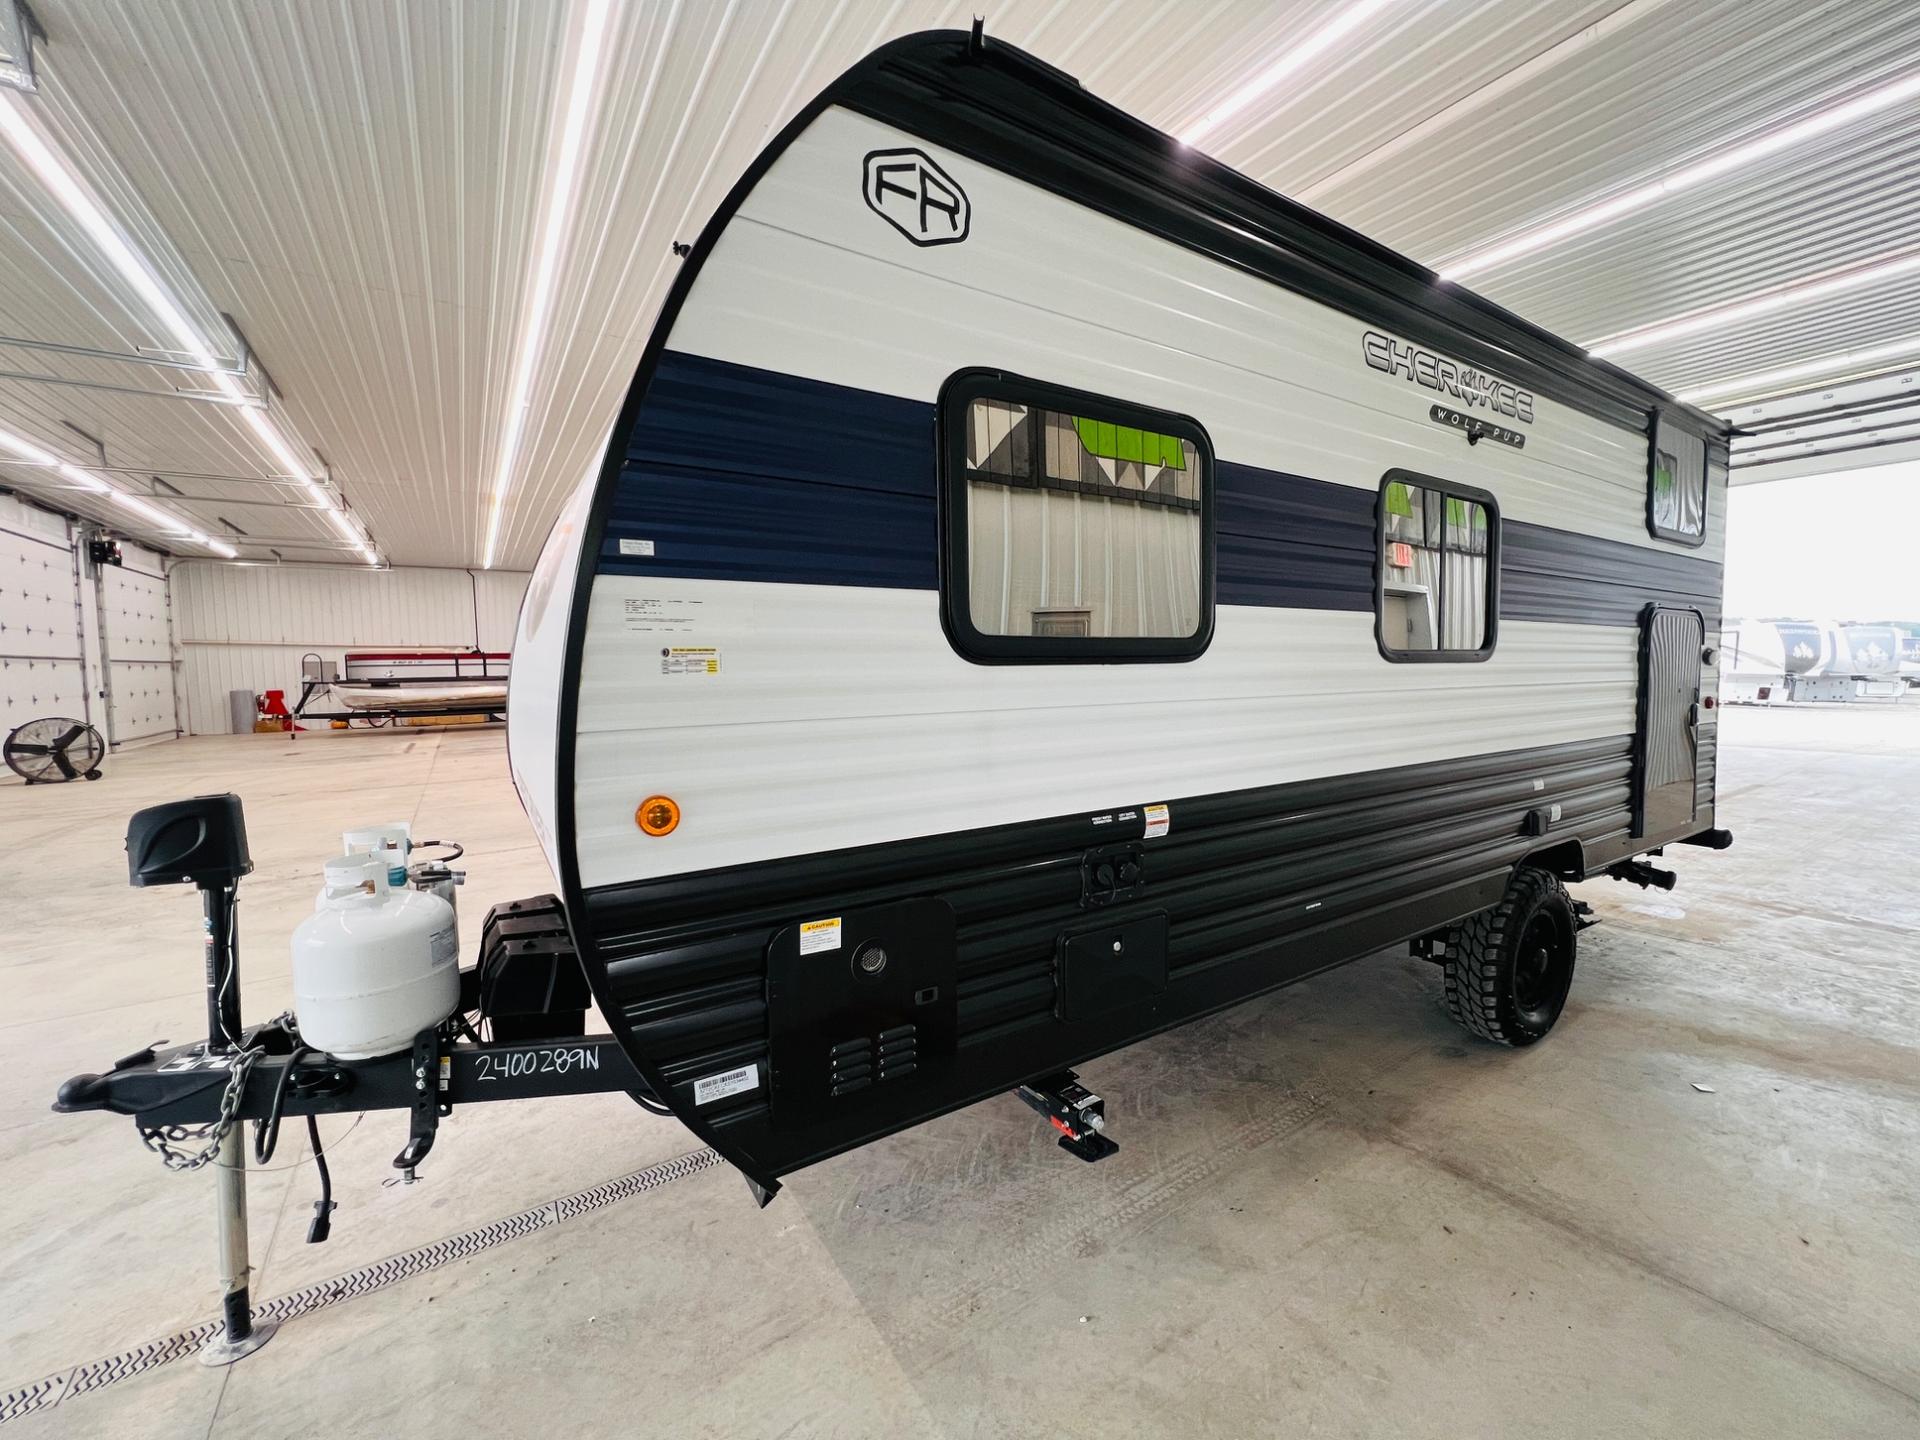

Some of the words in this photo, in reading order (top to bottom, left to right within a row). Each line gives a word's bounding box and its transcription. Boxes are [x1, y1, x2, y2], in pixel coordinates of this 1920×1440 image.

[874, 163, 960, 233] FR
[1436, 408, 1483, 432] WOLF
[1493, 427, 1521, 445] PUP
[474, 1045, 600, 1081] 2400289N
